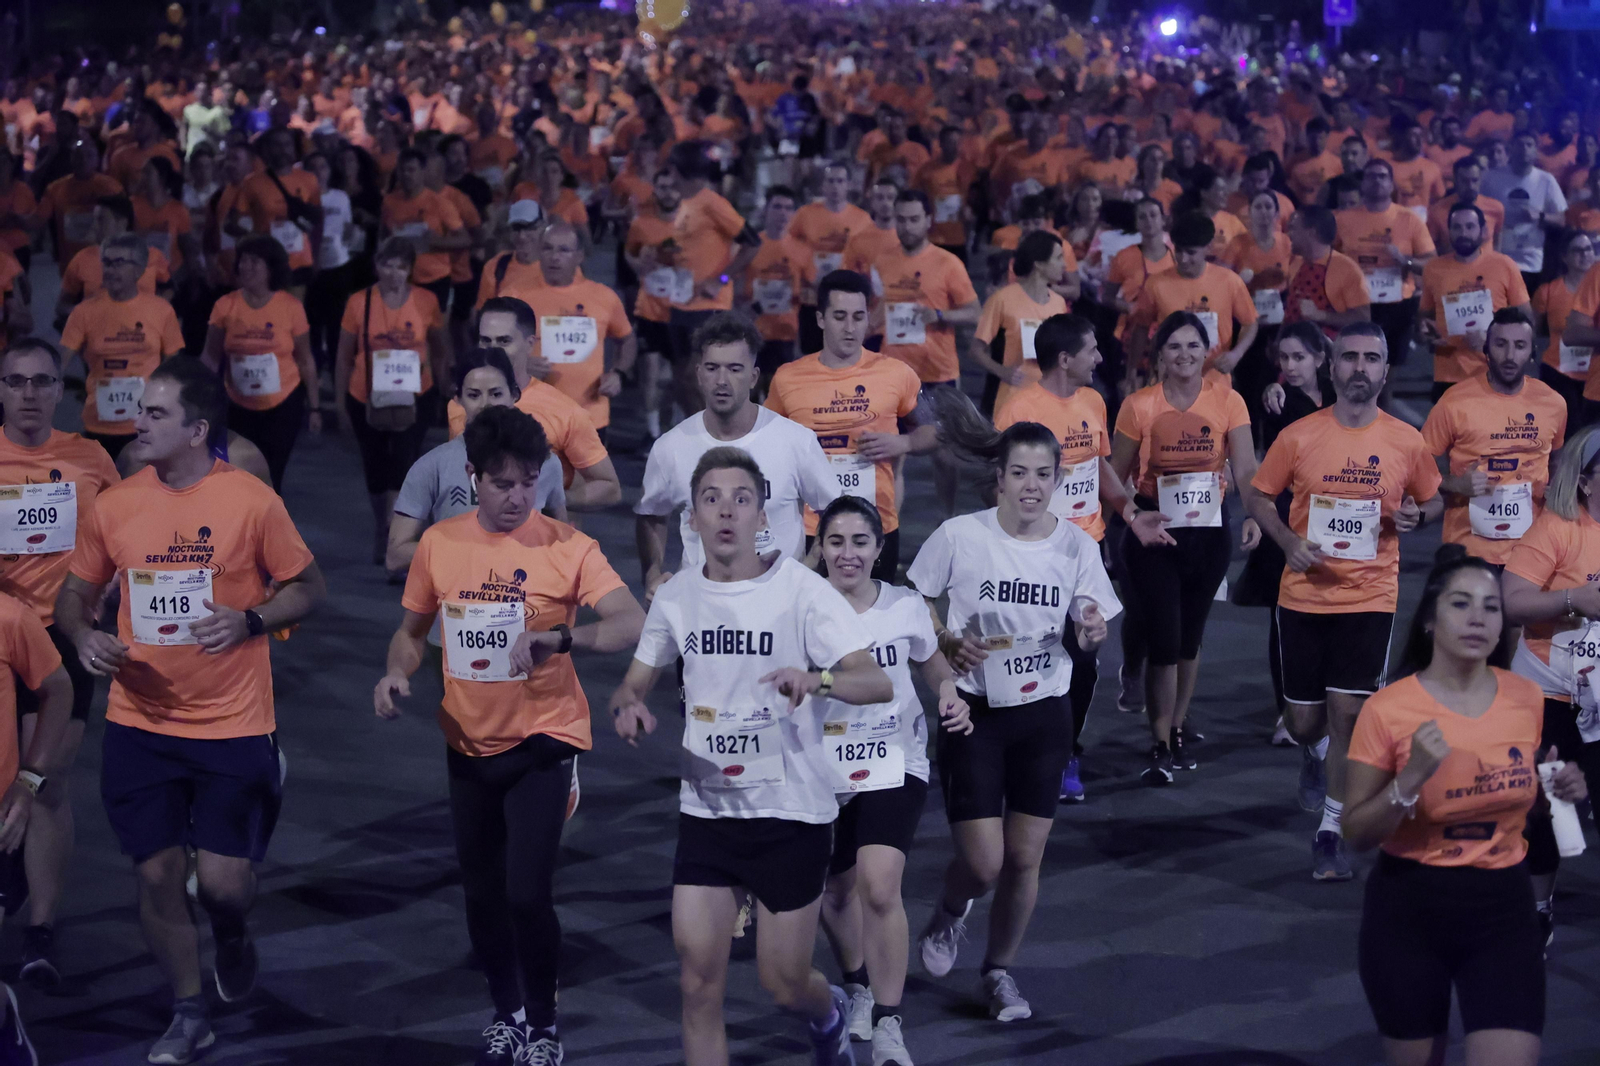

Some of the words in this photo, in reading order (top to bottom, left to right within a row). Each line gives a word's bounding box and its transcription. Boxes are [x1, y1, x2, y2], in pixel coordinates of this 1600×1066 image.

[1455, 304, 1485, 318] 19545
[108, 392, 133, 403] 4174
[813, 406, 848, 414] SEVILLA
[1177, 438, 1214, 446] NOCTURNA
[1490, 432, 1520, 440] SEVILLA
[1060, 441, 1080, 450] VILLA
[1161, 444, 1195, 452] SEVILLA
[1322, 475, 1358, 484] SEVILLA
[1340, 468, 1381, 477] NOCTURNA
[1063, 478, 1095, 496] 15726
[1173, 490, 1211, 505] 15728
[17, 507, 57, 525] 2609
[1488, 503, 1519, 516] 4160
[1327, 518, 1362, 534] 4309
[168, 545, 214, 553] NOCTURNA
[145, 555, 188, 563] SEVILLA
[458, 590, 500, 602] SEVILLA
[998, 577, 1059, 607] BÍBELO
[149, 596, 190, 614] 4118
[457, 630, 508, 649] 18649
[701, 625, 773, 656] BÍBELO
[870, 644, 897, 668] LO
[1003, 652, 1051, 676] 18272
[705, 734, 760, 754] 18271
[835, 741, 887, 762] 18276
[1445, 782, 1506, 799] SEVILLA
